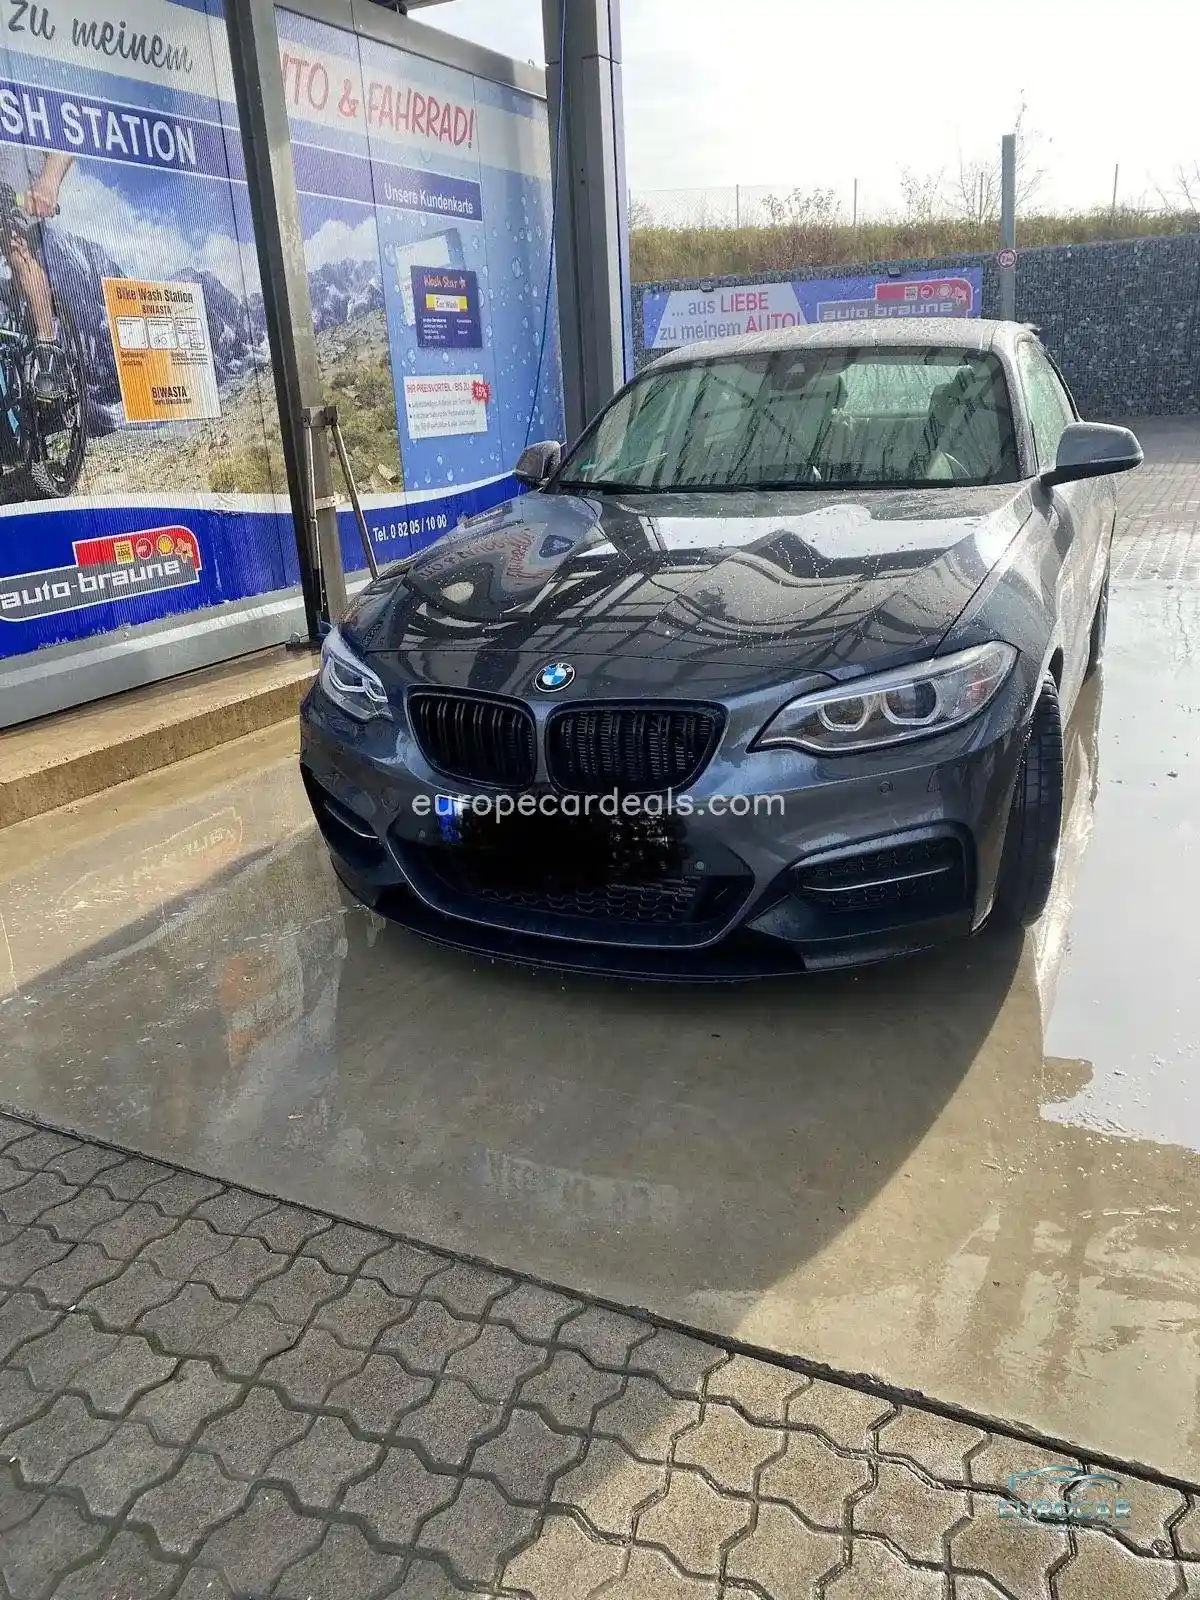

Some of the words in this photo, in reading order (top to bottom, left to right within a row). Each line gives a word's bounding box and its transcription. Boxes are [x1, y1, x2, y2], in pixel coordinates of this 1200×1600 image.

[8, 0, 55, 40] zu
[73, 18, 194, 74] meinem
[282, 51, 329, 110] TO
[367, 80, 475, 149] FAHRRAD!
[0, 89, 51, 140] SH
[60, 101, 197, 165] STATION
[384, 182, 418, 205] Unsere
[420, 188, 474, 214] Kundenkarte
[115, 286, 137, 300] Bike
[138, 288, 162, 302] Wash
[164, 289, 194, 304] Station
[688, 299, 716, 316] aus
[720, 291, 769, 313] LIEBE
[660, 325, 677, 341] zu
[681, 320, 741, 340] meinem
[151, 385, 188, 399] BIWASTA
[373, 525, 389, 542] Tel.
[390, 522, 397, 539] 0
[398, 521, 409, 537] 82
[409, 518, 421, 534] 05
[426, 516, 436, 531] 10
[437, 514, 448, 529] 00
[0, 559, 181, 610] auto-braune
